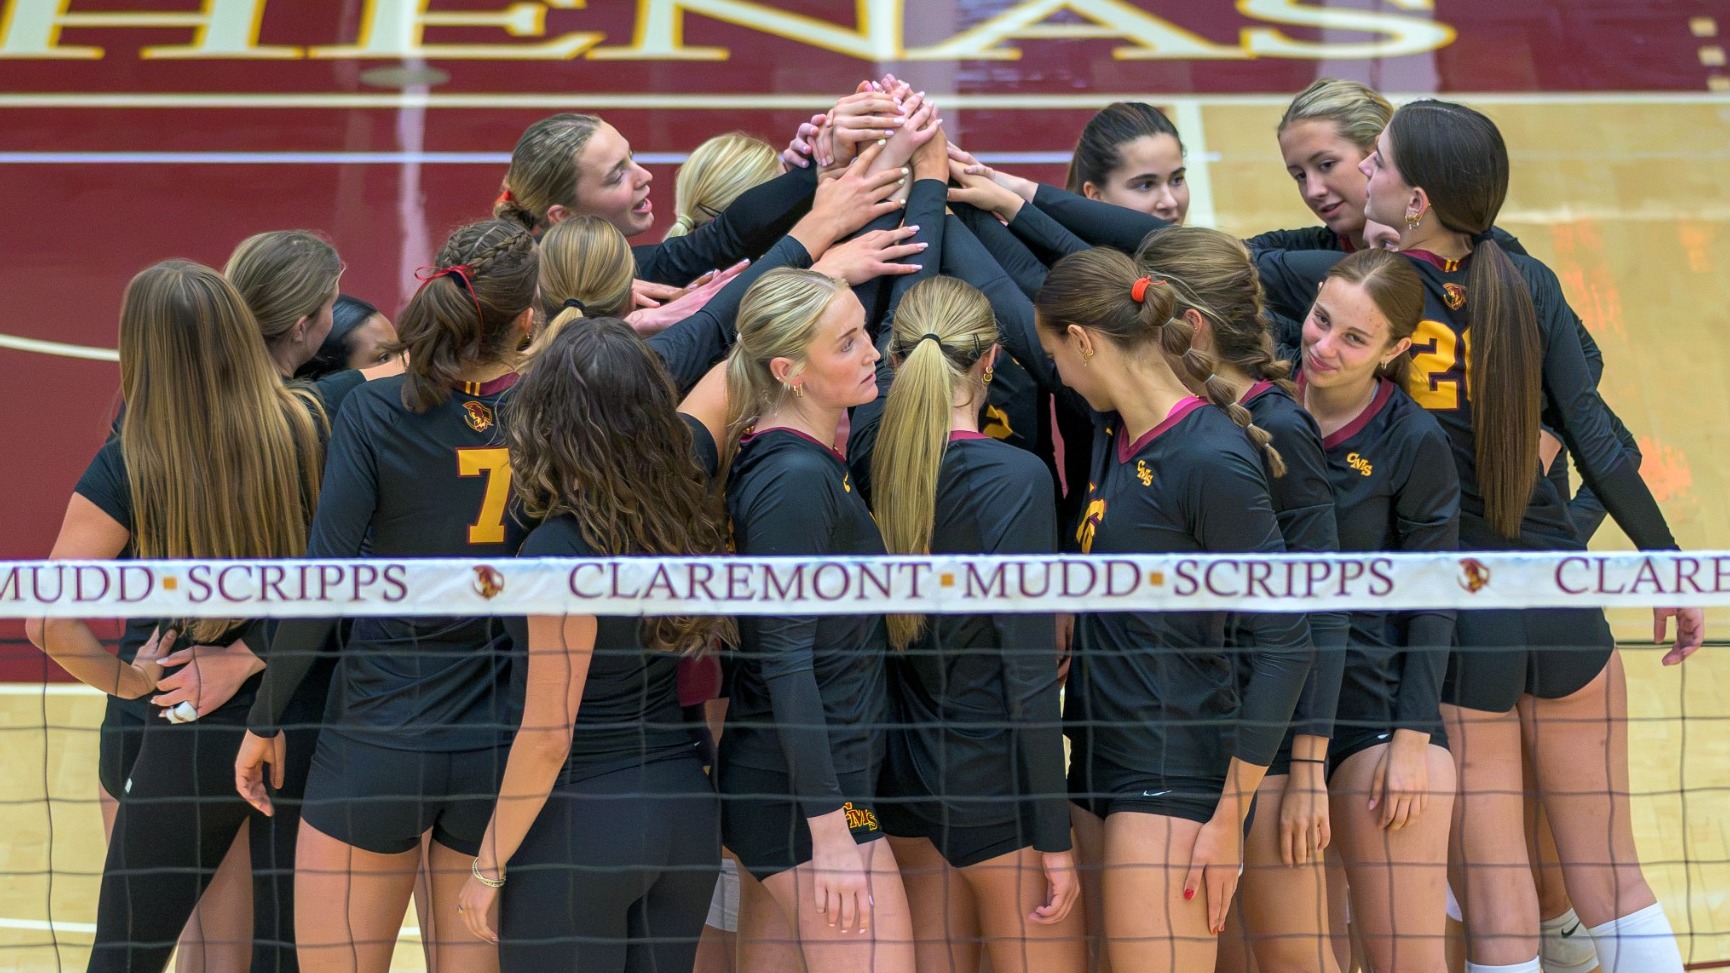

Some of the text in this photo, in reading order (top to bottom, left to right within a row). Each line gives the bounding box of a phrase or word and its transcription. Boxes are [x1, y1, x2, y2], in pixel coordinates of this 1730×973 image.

[1409, 319, 1472, 411] 2
[1136, 459, 1154, 487] CMS
[1346, 452, 1374, 478] CMS
[456, 446, 513, 545] 7
[187, 563, 409, 602] SCRIPPS
[568, 557, 1395, 602] CLAREMONT MUDD SCRIPPS
[842, 801, 878, 832] MS
